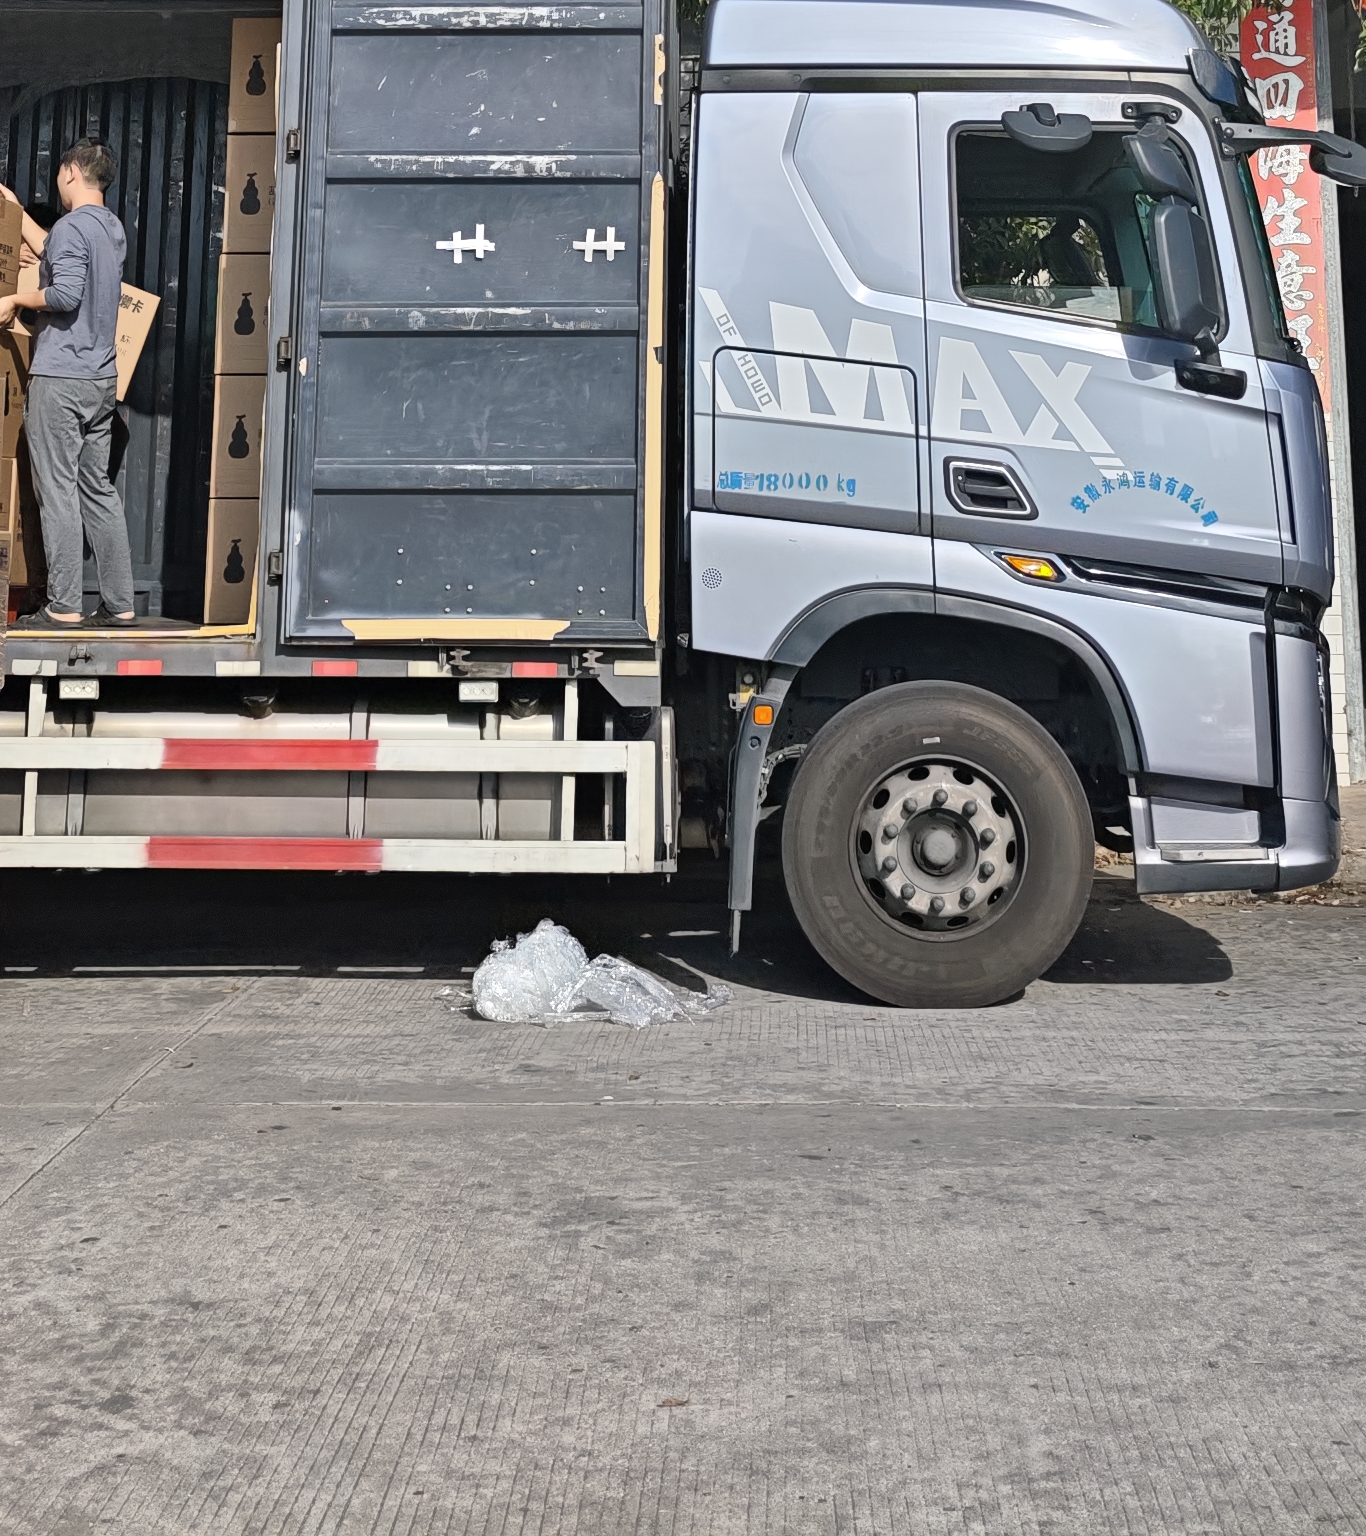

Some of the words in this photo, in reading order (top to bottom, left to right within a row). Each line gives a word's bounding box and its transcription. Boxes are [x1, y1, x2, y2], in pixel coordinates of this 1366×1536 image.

[837, 473, 857, 497] kg
[1070, 471, 1219, 527] 安徽永鸿运输有限公司
